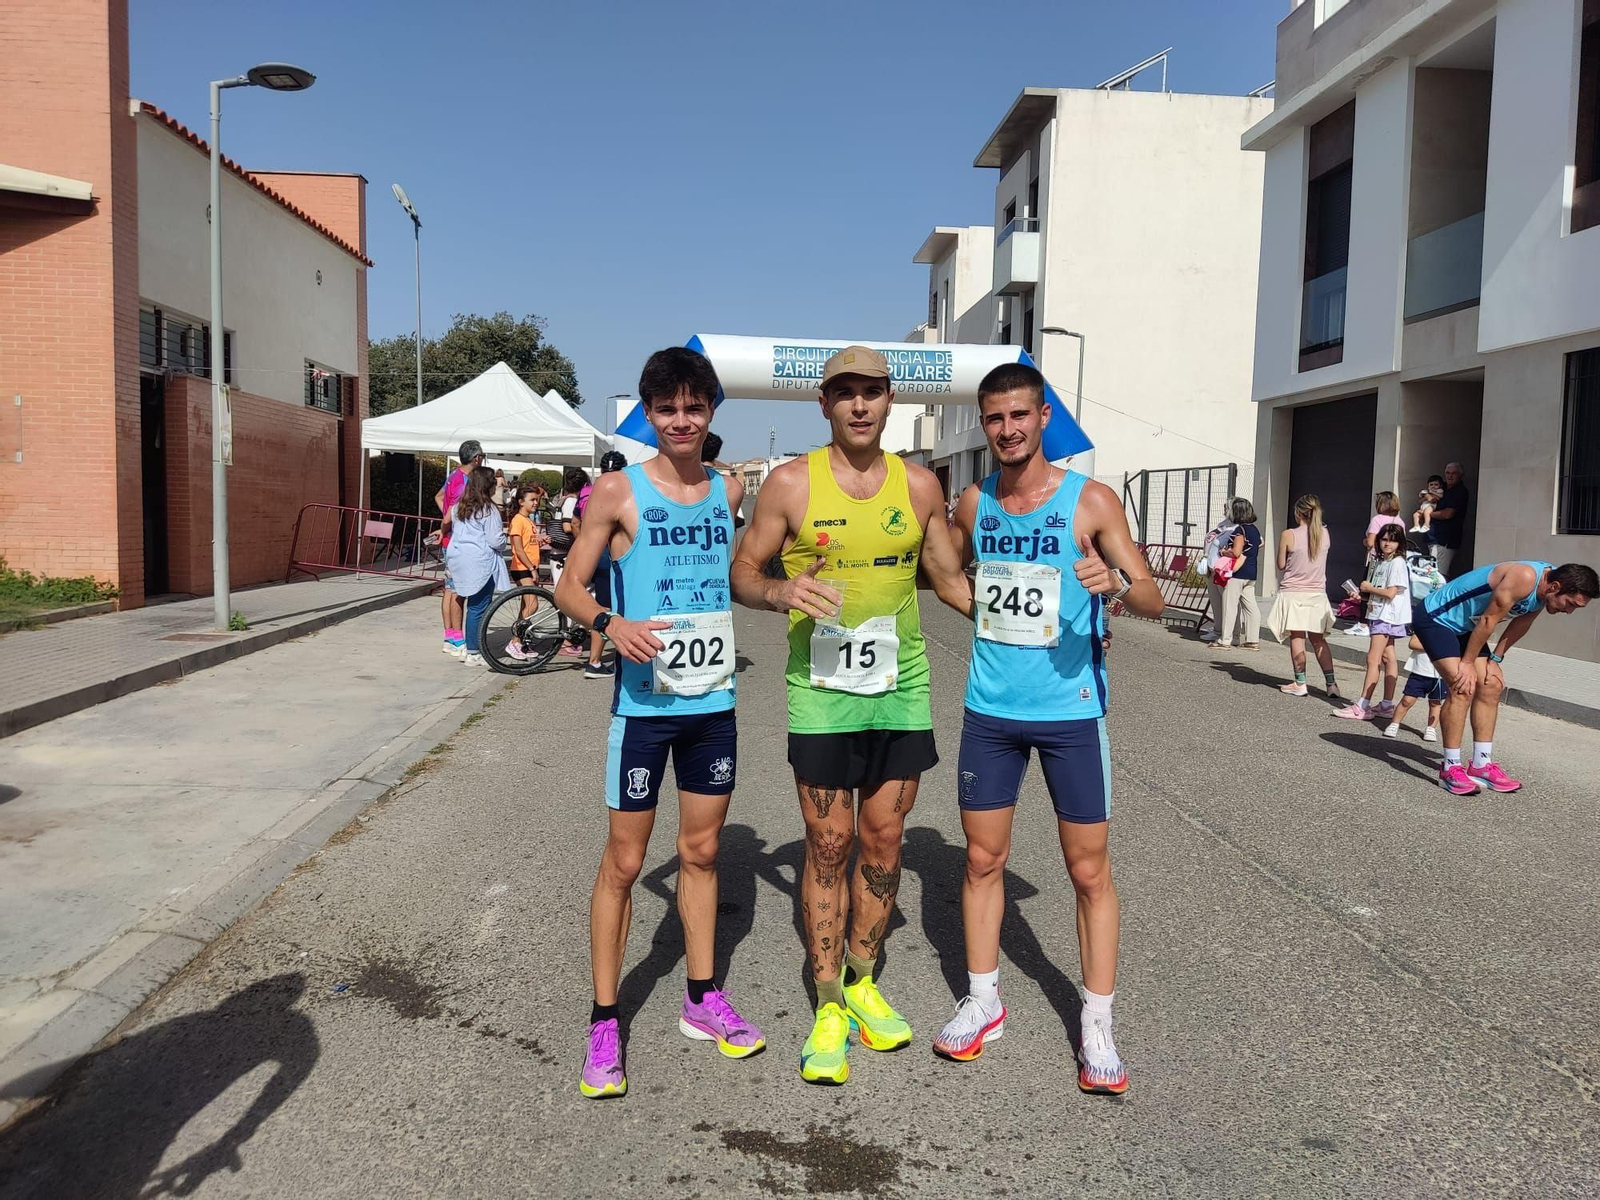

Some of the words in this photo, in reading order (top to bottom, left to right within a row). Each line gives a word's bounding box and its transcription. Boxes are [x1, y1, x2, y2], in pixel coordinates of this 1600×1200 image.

[773, 347, 838, 361] CIRCUITO
[882, 351, 930, 364] INCIAL
[935, 353, 953, 365] DE
[773, 361, 824, 377] CARRE
[887, 365, 953, 380] PULARES
[772, 379, 821, 390] DIPUTA
[648, 517, 728, 551] nerja
[980, 528, 1060, 561] nerja
[664, 555, 720, 567] ATLETISMO
[987, 585, 1044, 617] 248
[667, 636, 724, 669] 202
[839, 640, 876, 669] 15
[894, 781, 906, 813] LINO
